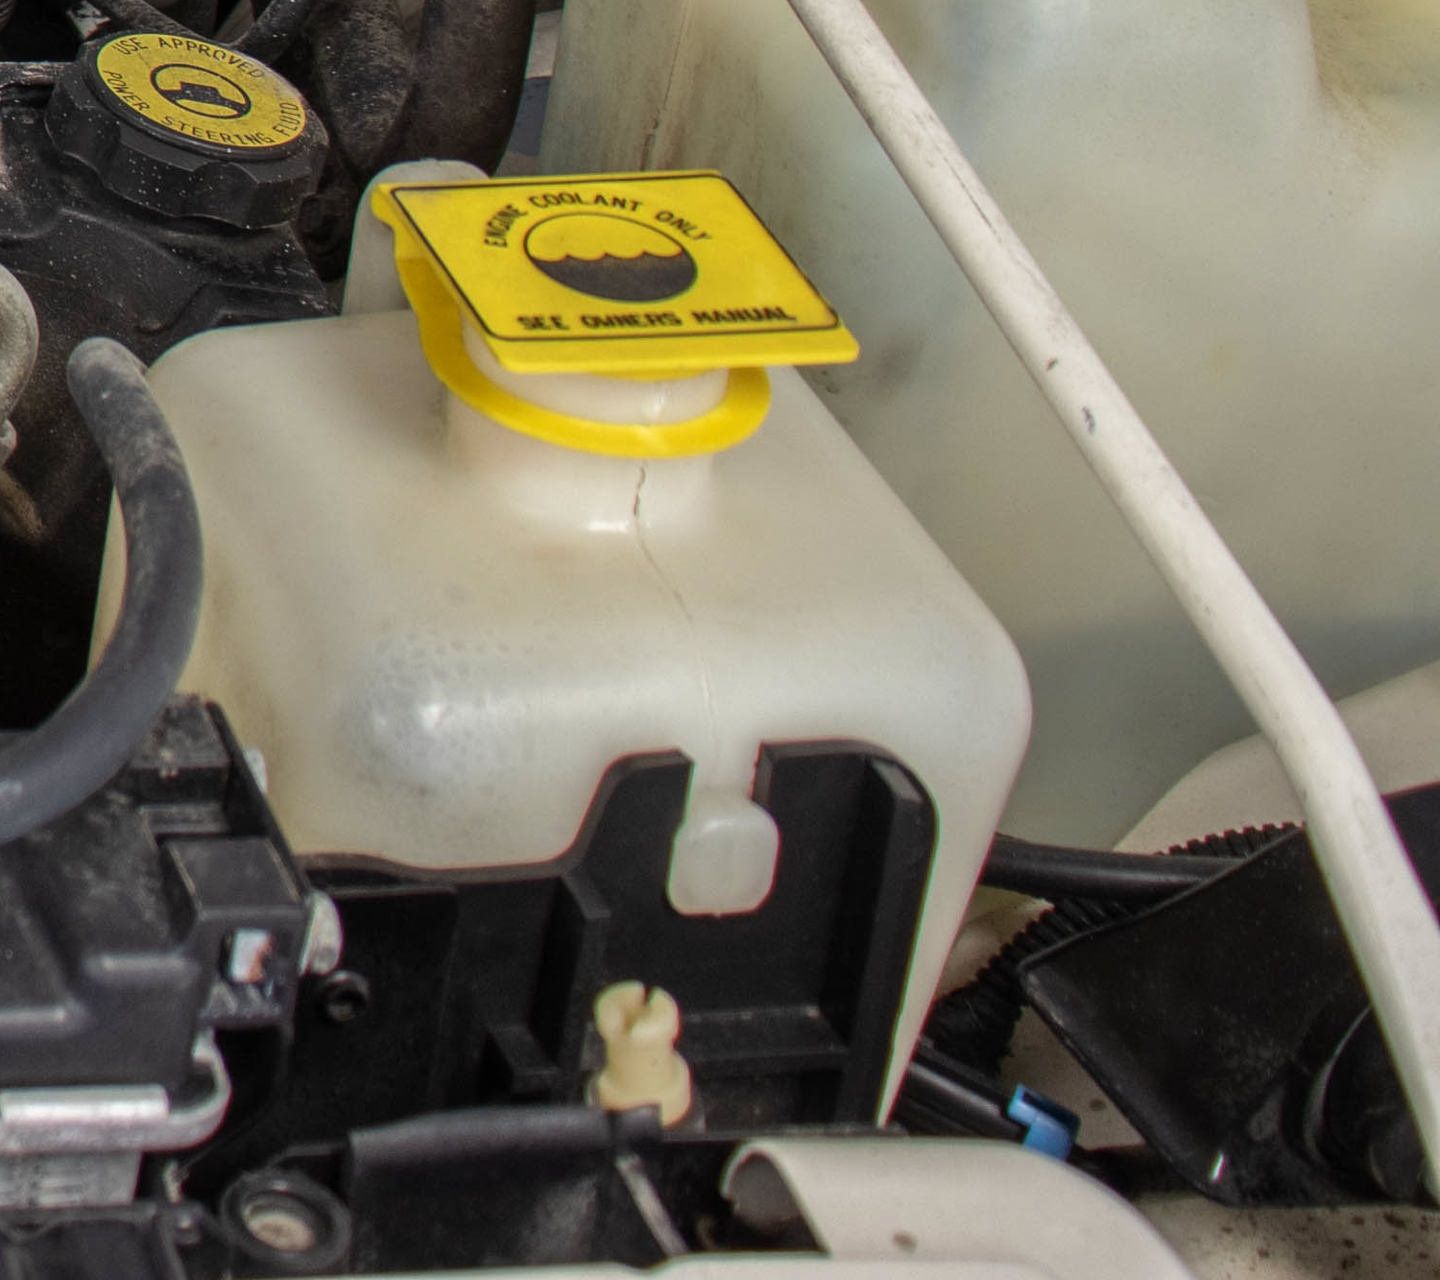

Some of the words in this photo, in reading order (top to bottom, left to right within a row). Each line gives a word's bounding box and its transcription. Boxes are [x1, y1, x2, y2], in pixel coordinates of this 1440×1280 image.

[113, 37, 148, 56] USE
[157, 36, 265, 79] APPROVED
[102, 69, 152, 112] POWER
[160, 115, 273, 146] STEERING
[272, 102, 302, 137] FLUID
[484, 203, 528, 249] ENGINE
[528, 191, 643, 213] COOLANT
[654, 211, 714, 242] ONLY
[516, 314, 569, 332] SEE
[580, 312, 683, 330] OWNERS
[691, 305, 798, 326] MANUAL
